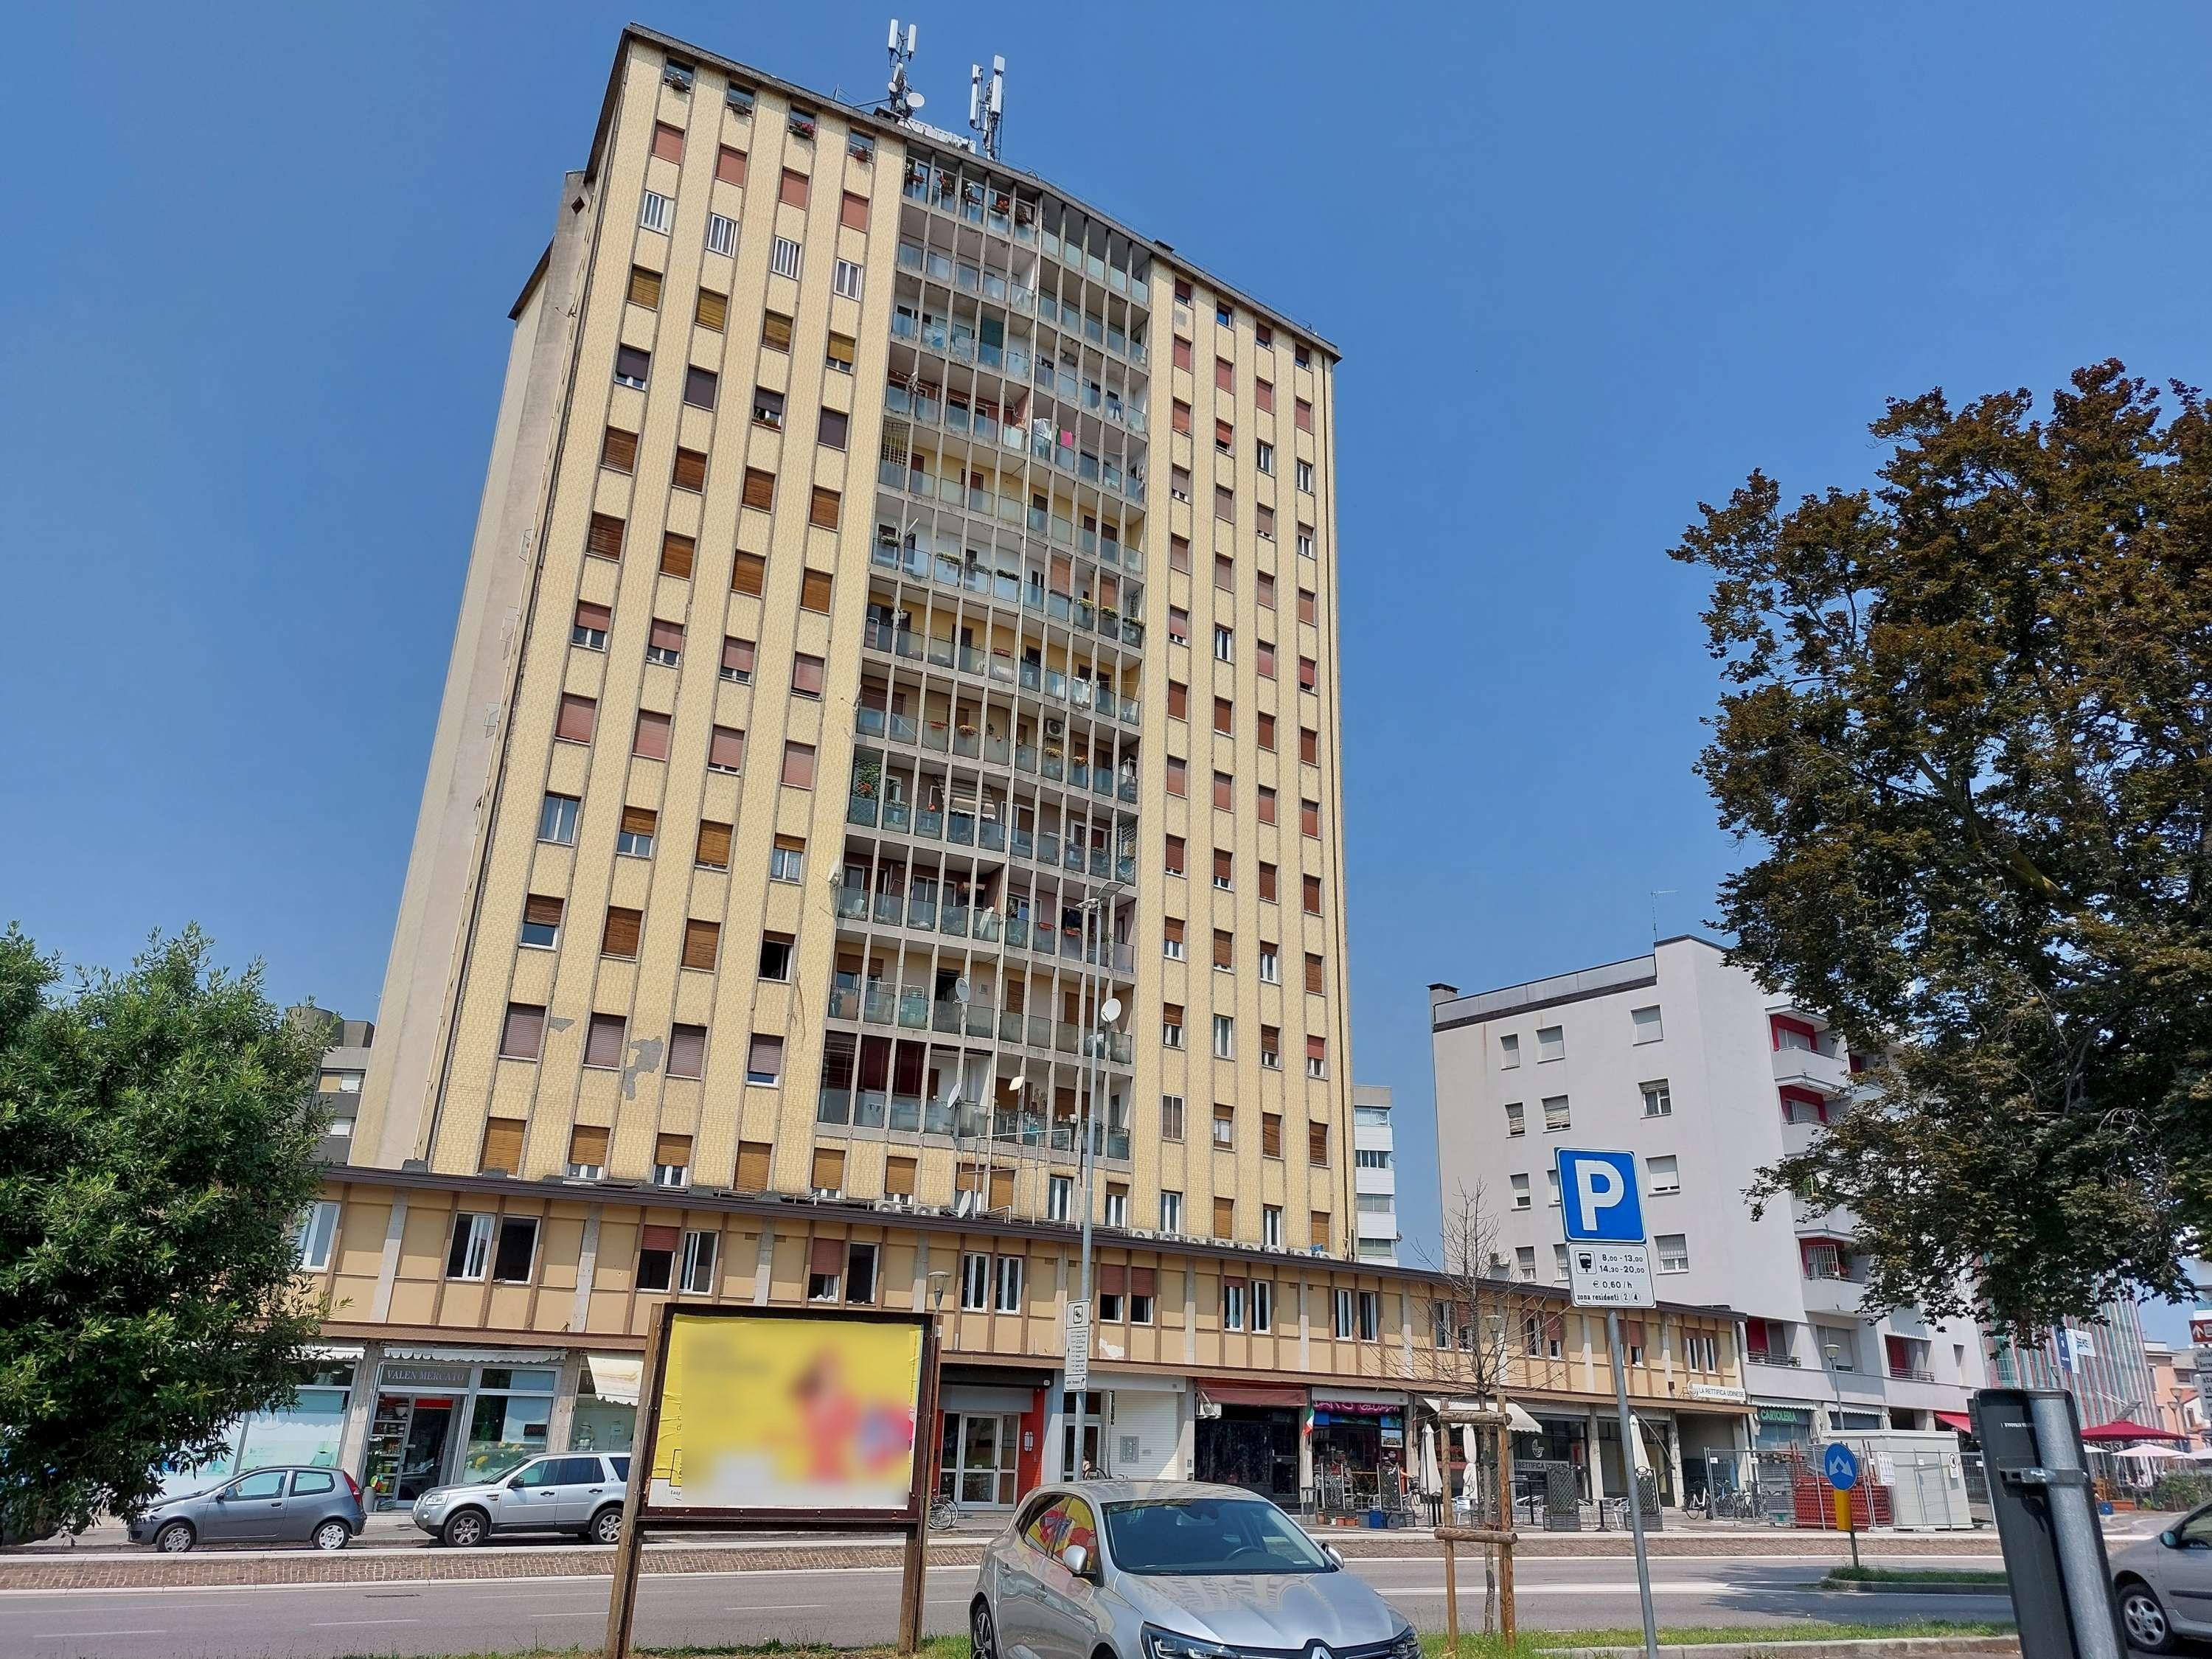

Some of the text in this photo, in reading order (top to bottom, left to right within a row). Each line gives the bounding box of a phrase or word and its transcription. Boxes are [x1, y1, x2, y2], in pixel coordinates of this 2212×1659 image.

[1575, 1160, 1624, 1231] P
[1593, 1280, 1599, 1288] €
[1593, 1293, 1619, 1301] residenti
[1624, 1293, 1628, 1301] 2
[388, 1369, 465, 1381] VALEN MERCATO
[1761, 1409, 1798, 1422] CARTOLERIA
